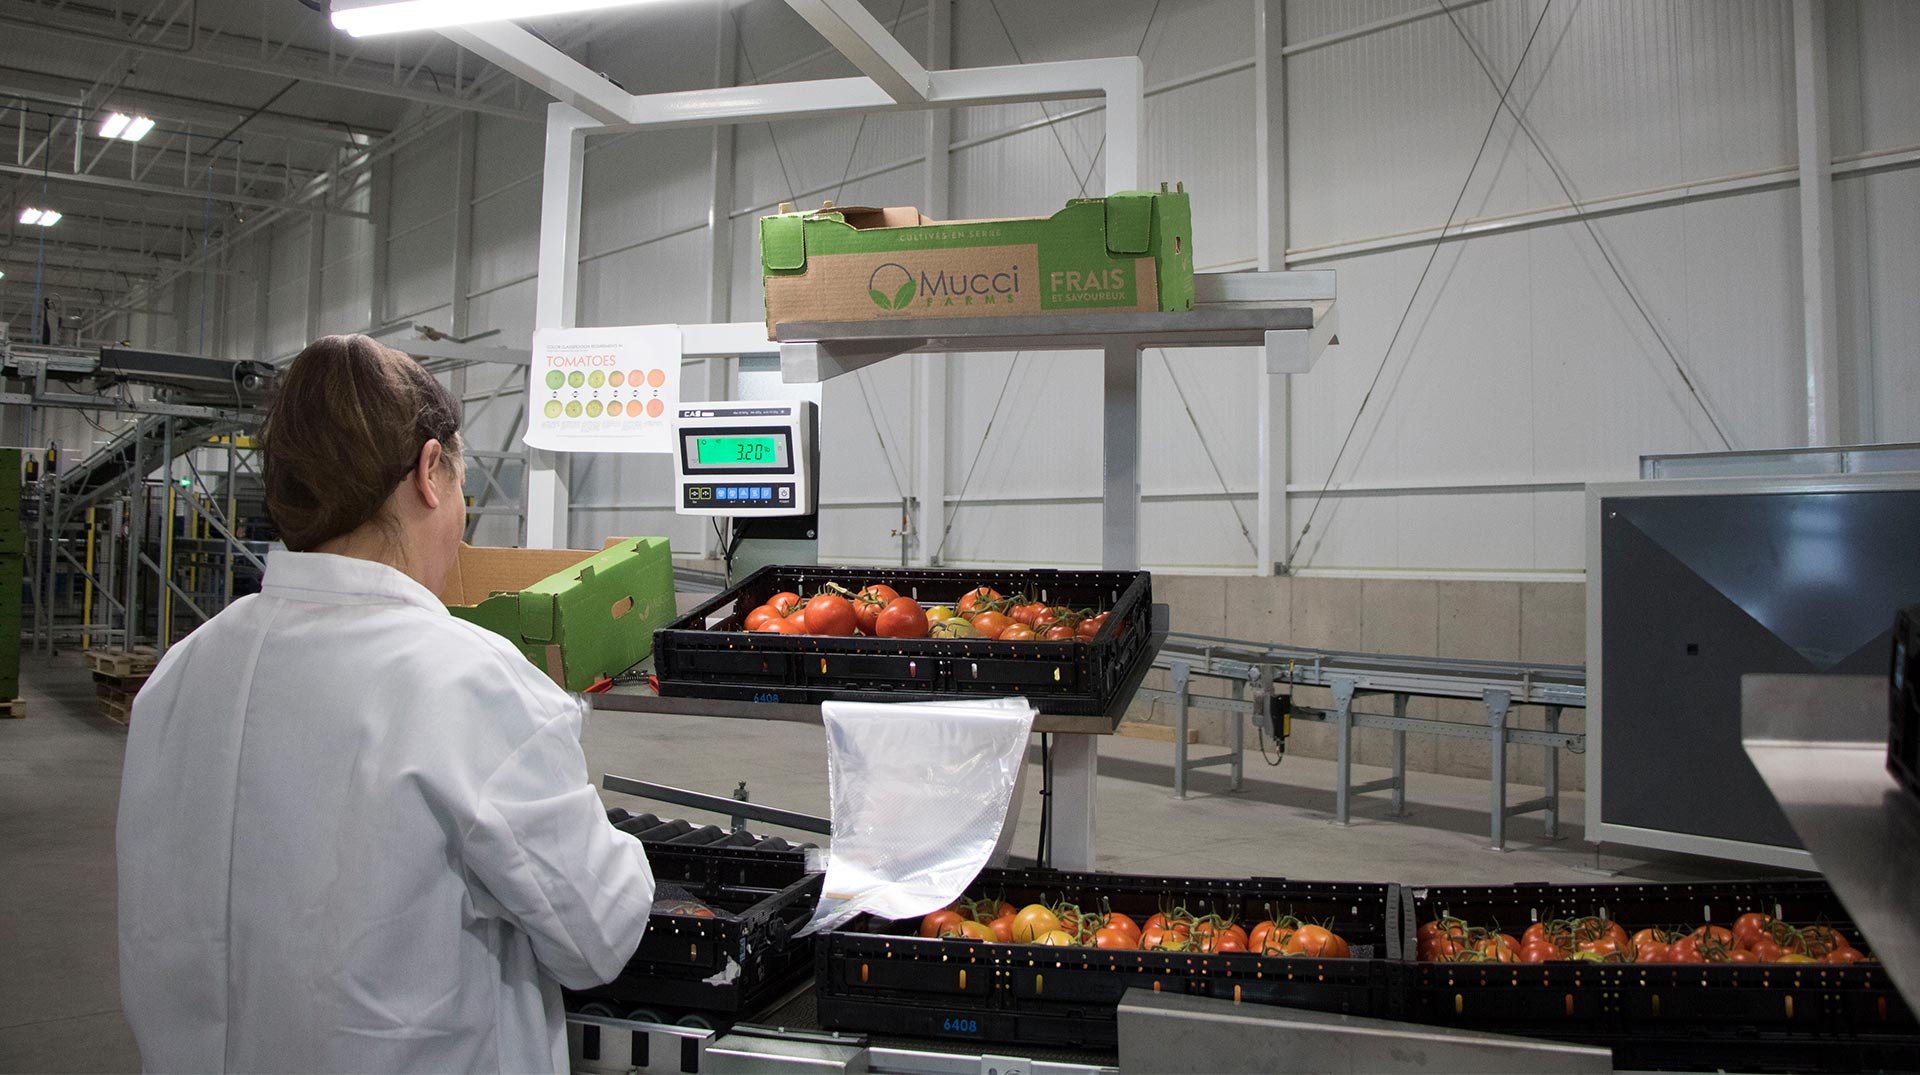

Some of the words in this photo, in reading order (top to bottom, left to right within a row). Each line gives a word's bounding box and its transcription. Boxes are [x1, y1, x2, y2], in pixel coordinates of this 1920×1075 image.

[951, 231, 964, 240] EN
[969, 229, 1001, 238] SERRE
[920, 265, 1019, 296] Mucci
[1050, 269, 1125, 292] FRAIS
[926, 294, 1015, 306] FARMS
[1051, 294, 1063, 303] ET
[1065, 291, 1126, 302] SAVOUREUX
[546, 354, 617, 368] TOMATOES
[737, 444, 763, 461] 3.20
[753, 693, 779, 703] 6408
[943, 1018, 977, 1032] 6408
